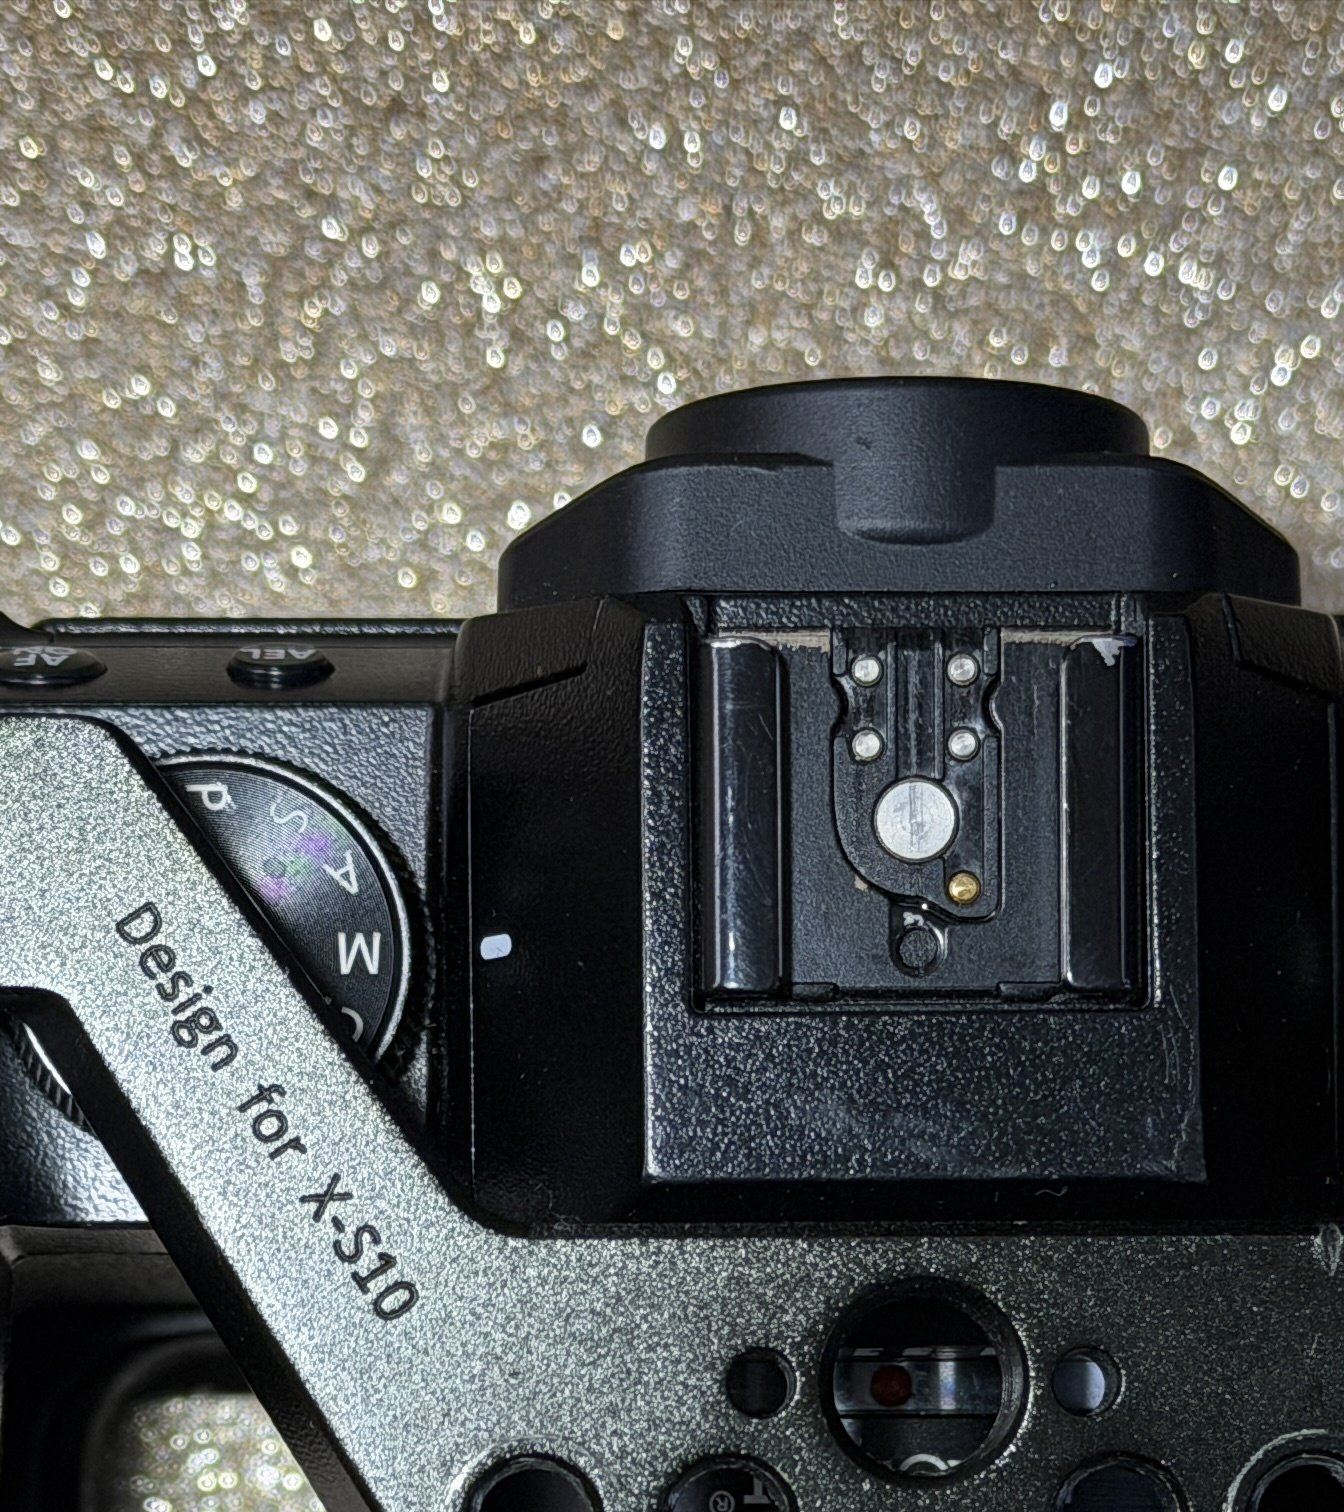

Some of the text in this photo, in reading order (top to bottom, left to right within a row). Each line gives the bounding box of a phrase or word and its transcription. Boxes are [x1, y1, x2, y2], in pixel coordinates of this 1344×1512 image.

[13, 654, 70, 667] AF
[239, 647, 316, 660] AEL
[184, 782, 233, 812] P
[269, 797, 308, 834] S
[321, 849, 359, 896] A
[338, 931, 381, 975] M
[115, 900, 422, 1321] Design for X-S10
